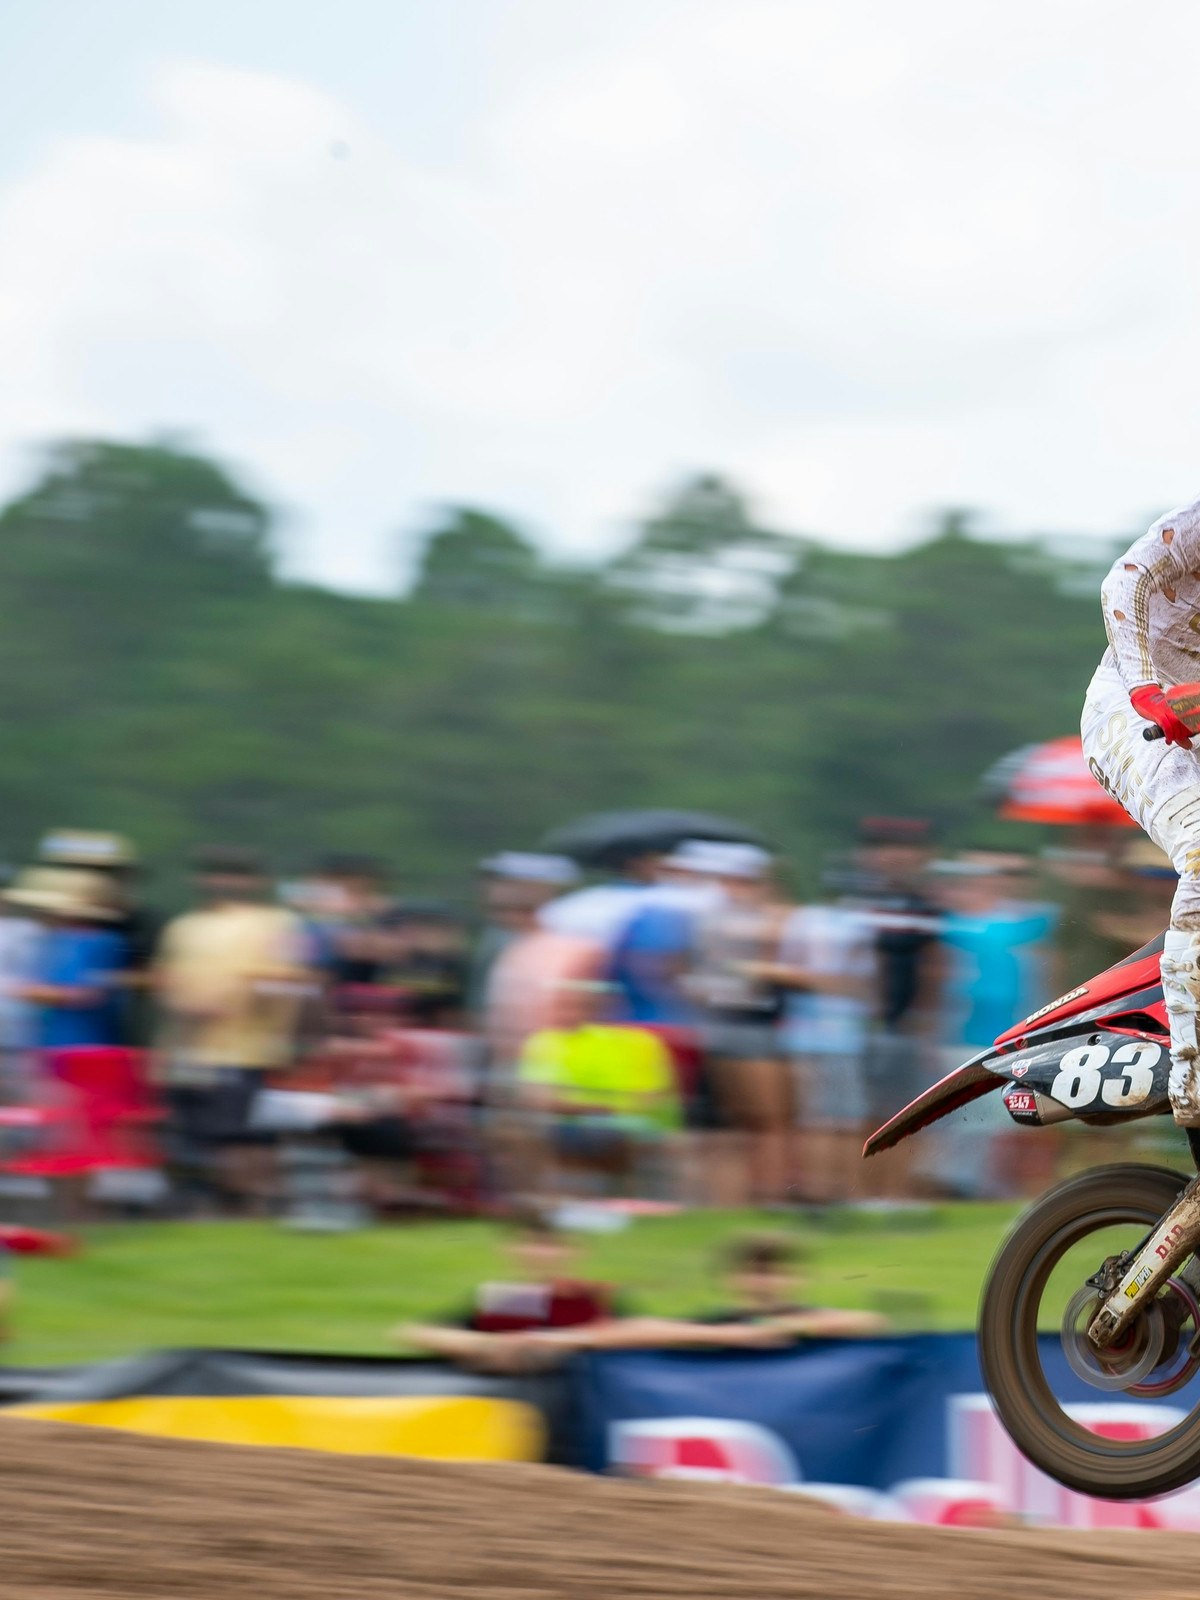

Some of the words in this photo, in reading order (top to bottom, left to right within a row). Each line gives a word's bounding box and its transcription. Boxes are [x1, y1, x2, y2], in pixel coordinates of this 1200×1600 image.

[1025, 986, 1089, 1026] HONDA
[1050, 1042, 1162, 1109] 83
[1124, 1280, 1141, 1299] PRO
